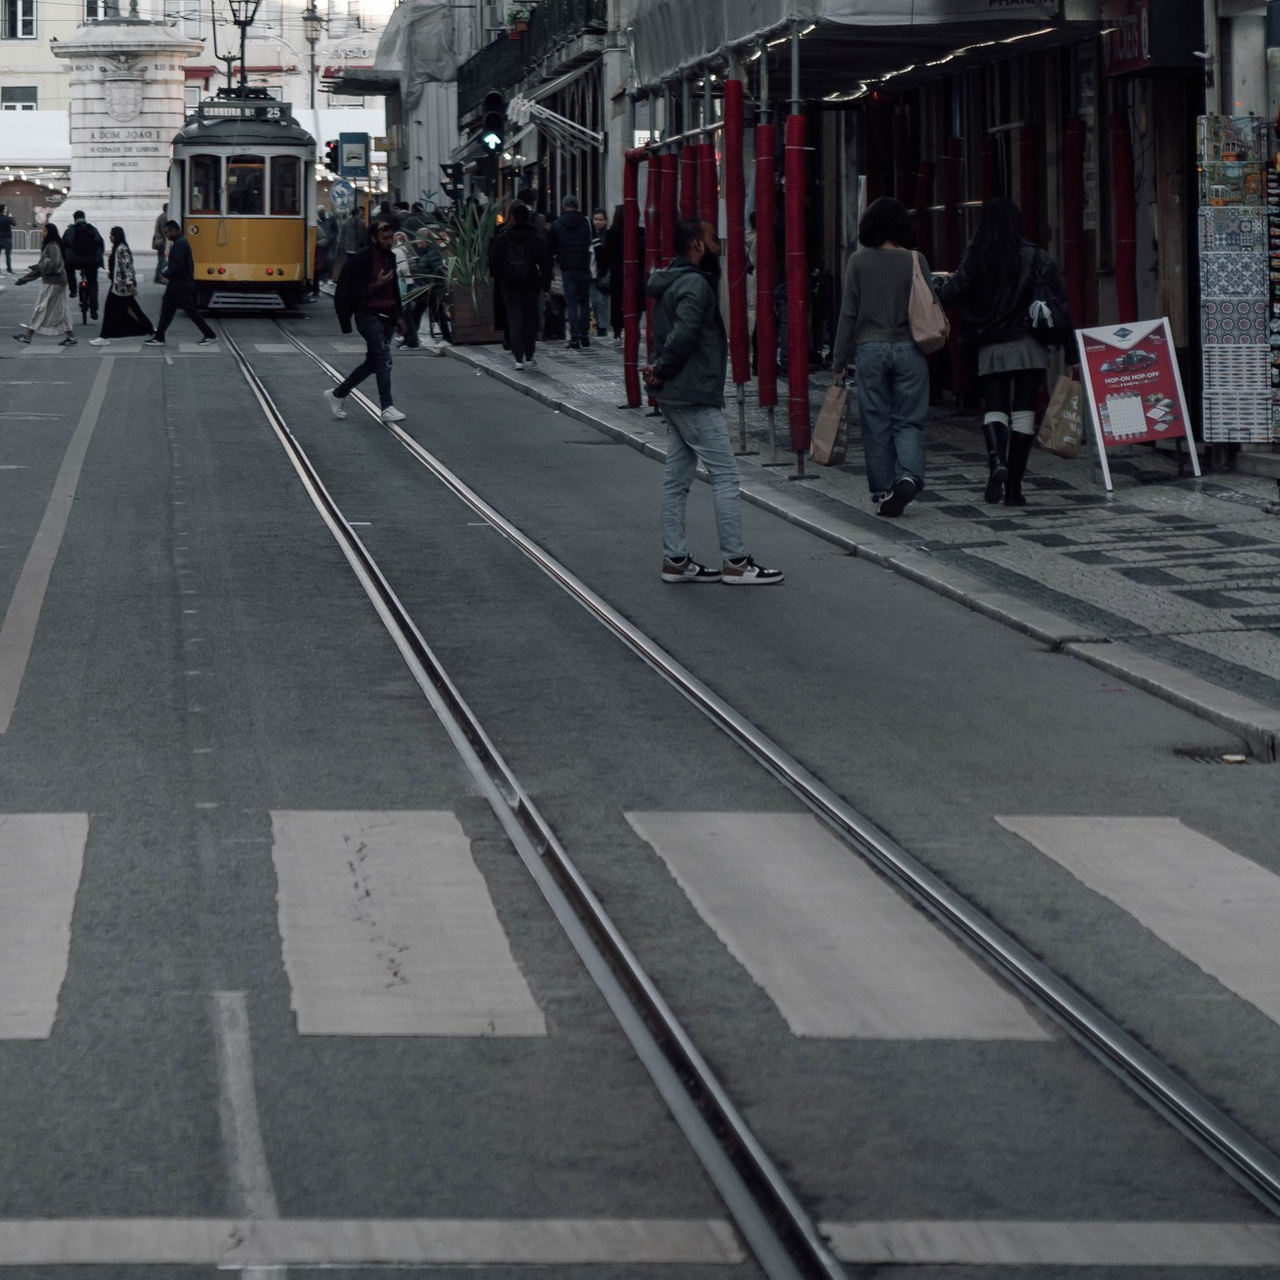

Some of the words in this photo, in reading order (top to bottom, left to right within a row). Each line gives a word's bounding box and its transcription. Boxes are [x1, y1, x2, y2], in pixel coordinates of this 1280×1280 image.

[266, 107, 281, 118] 25
[1104, 375, 1130, 383] HOP-ON
[1132, 371, 1160, 380] HOP-OFF
